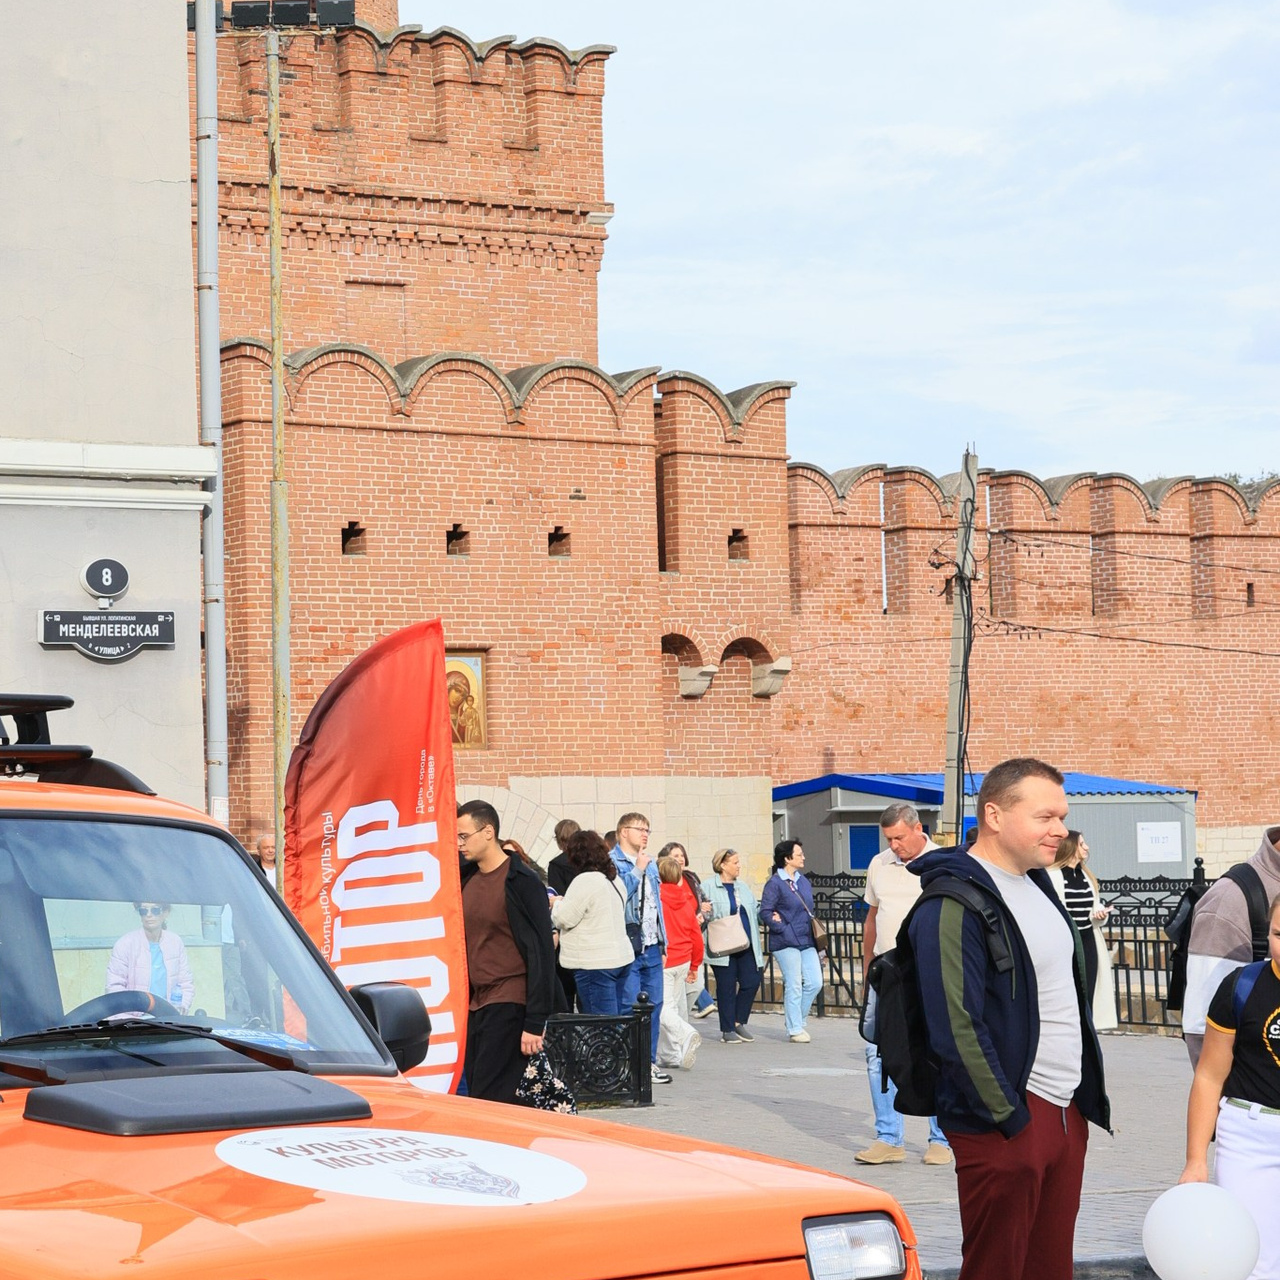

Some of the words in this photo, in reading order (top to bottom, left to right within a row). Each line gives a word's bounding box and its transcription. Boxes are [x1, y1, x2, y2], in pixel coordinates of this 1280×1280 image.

[101, 567, 113, 586] 8
[59, 623, 160, 639] МЕНДЕЛЕЕВСКАЯ
[99, 646, 121, 656] УЛИЦА
[418, 749, 426, 785] города
[415, 787, 425, 815] День
[427, 805, 435, 813] в
[321, 811, 336, 884] культуры
[1161, 835, 1169, 844] 27
[266, 1135, 433, 1158] КУЛЬТУРА
[312, 1146, 470, 1170] МОТОРОВ
